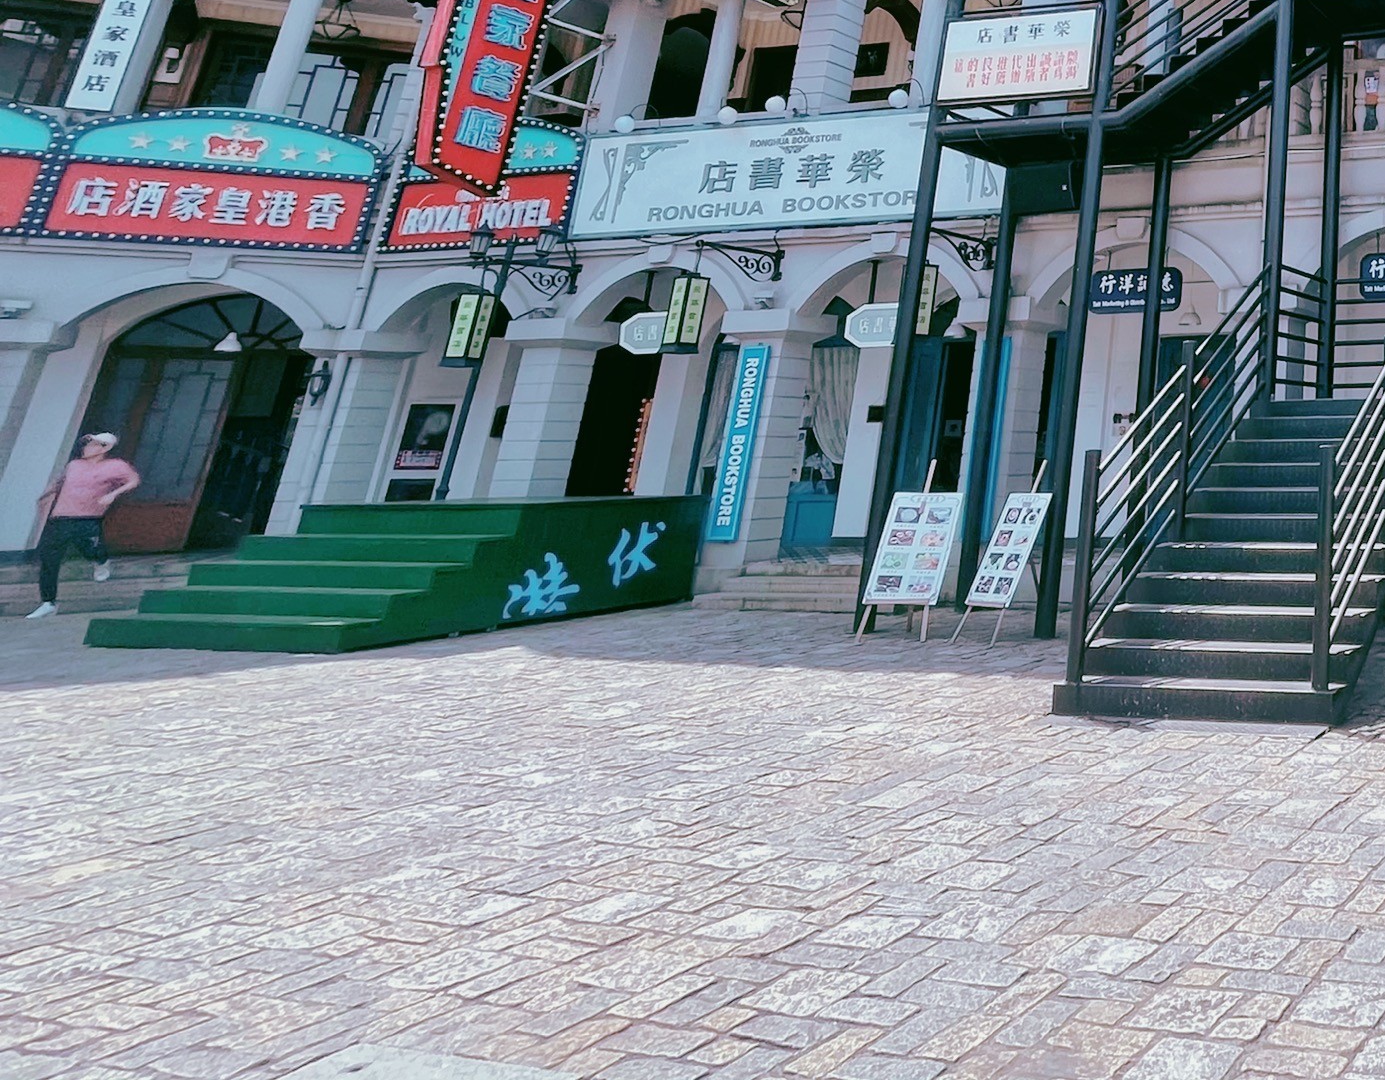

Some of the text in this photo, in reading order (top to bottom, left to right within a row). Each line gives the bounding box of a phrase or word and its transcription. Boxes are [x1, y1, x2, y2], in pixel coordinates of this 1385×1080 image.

[976, 19, 1072, 44] 榮華書店
[749, 133, 842, 148] RONGHUA BOOKSTORE
[698, 148, 885, 194] 榮華書店
[67, 176, 347, 230] 香港皇家酒店
[400, 199, 551, 236] ROYAL HOTEL
[647, 189, 918, 222] RONGHUA BOOKSTOR
[715, 355, 760, 528] RONGHUA BOOKSTORE
